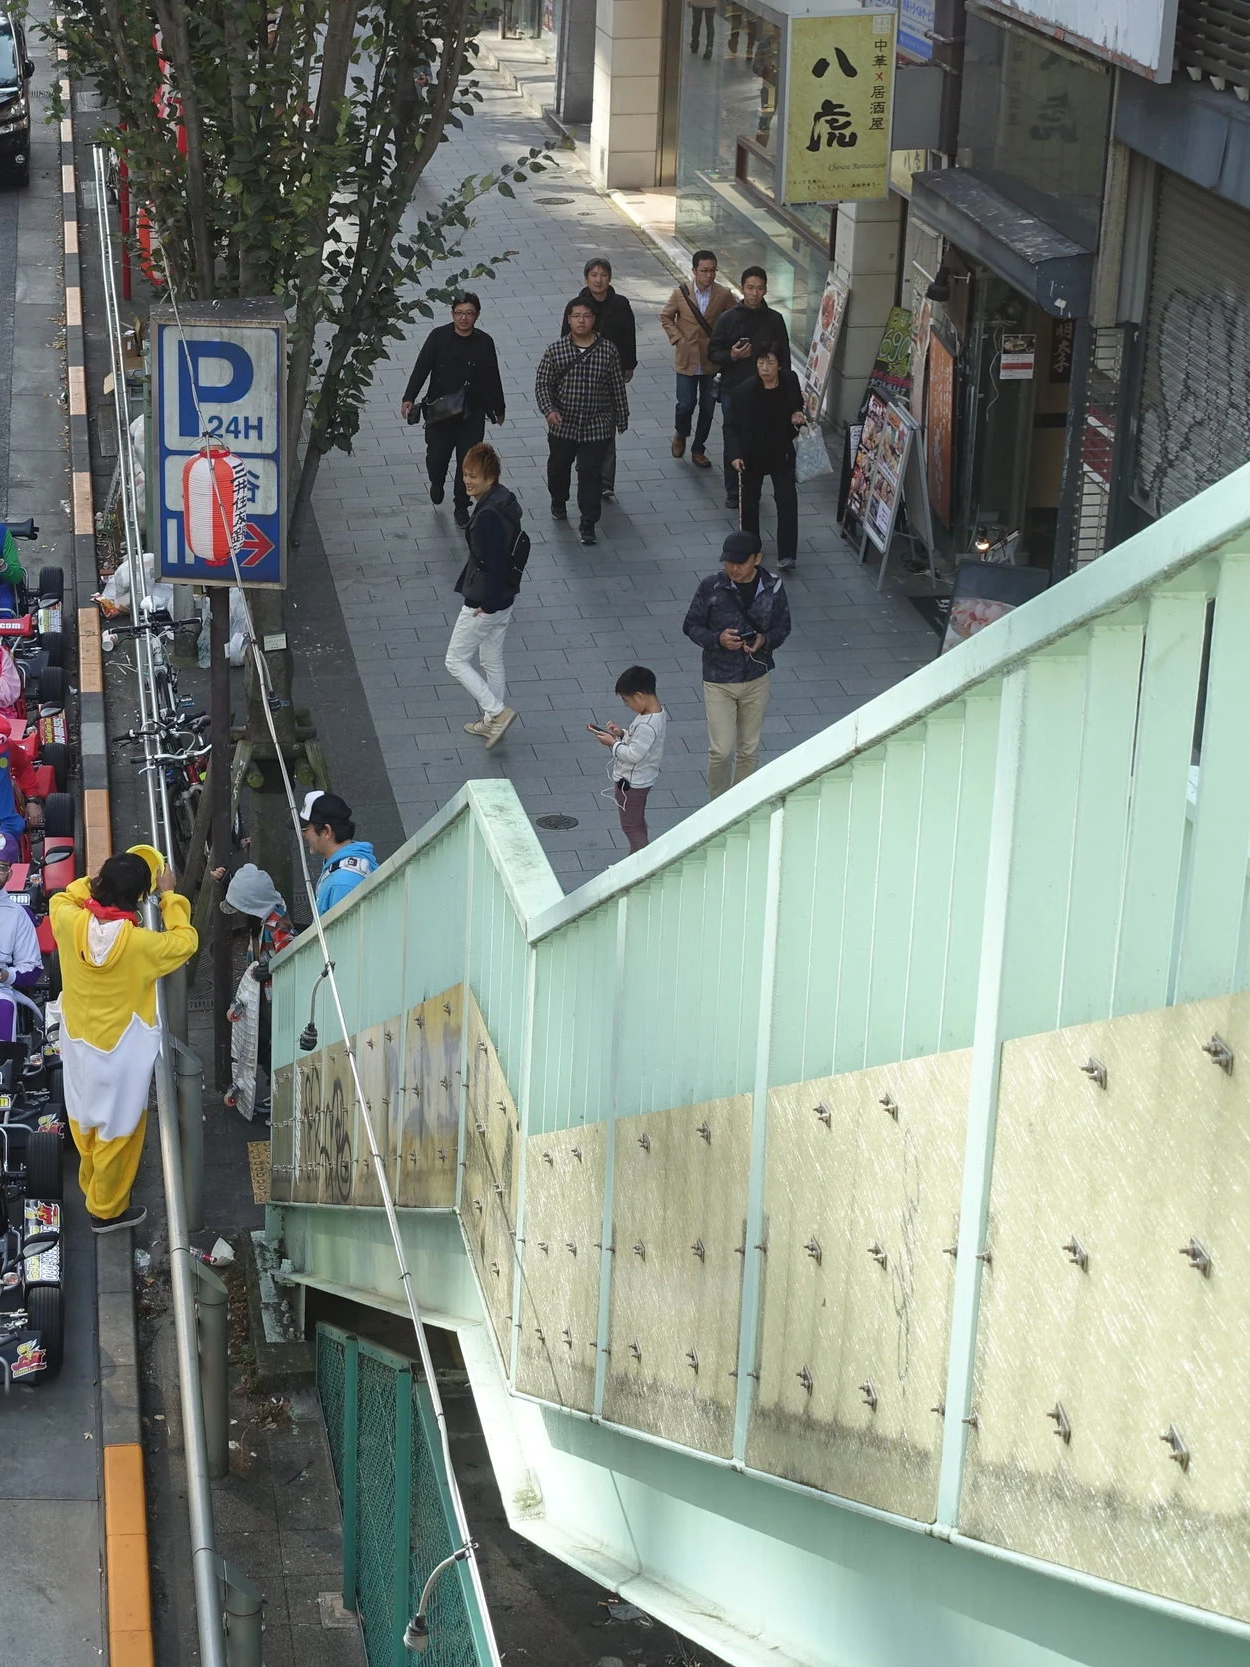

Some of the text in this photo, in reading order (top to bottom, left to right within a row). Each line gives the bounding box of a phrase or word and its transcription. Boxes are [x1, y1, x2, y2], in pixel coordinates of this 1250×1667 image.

[806, 47, 858, 152] 八虎
[178, 340, 255, 437] P
[207, 415, 263, 441] 24H
